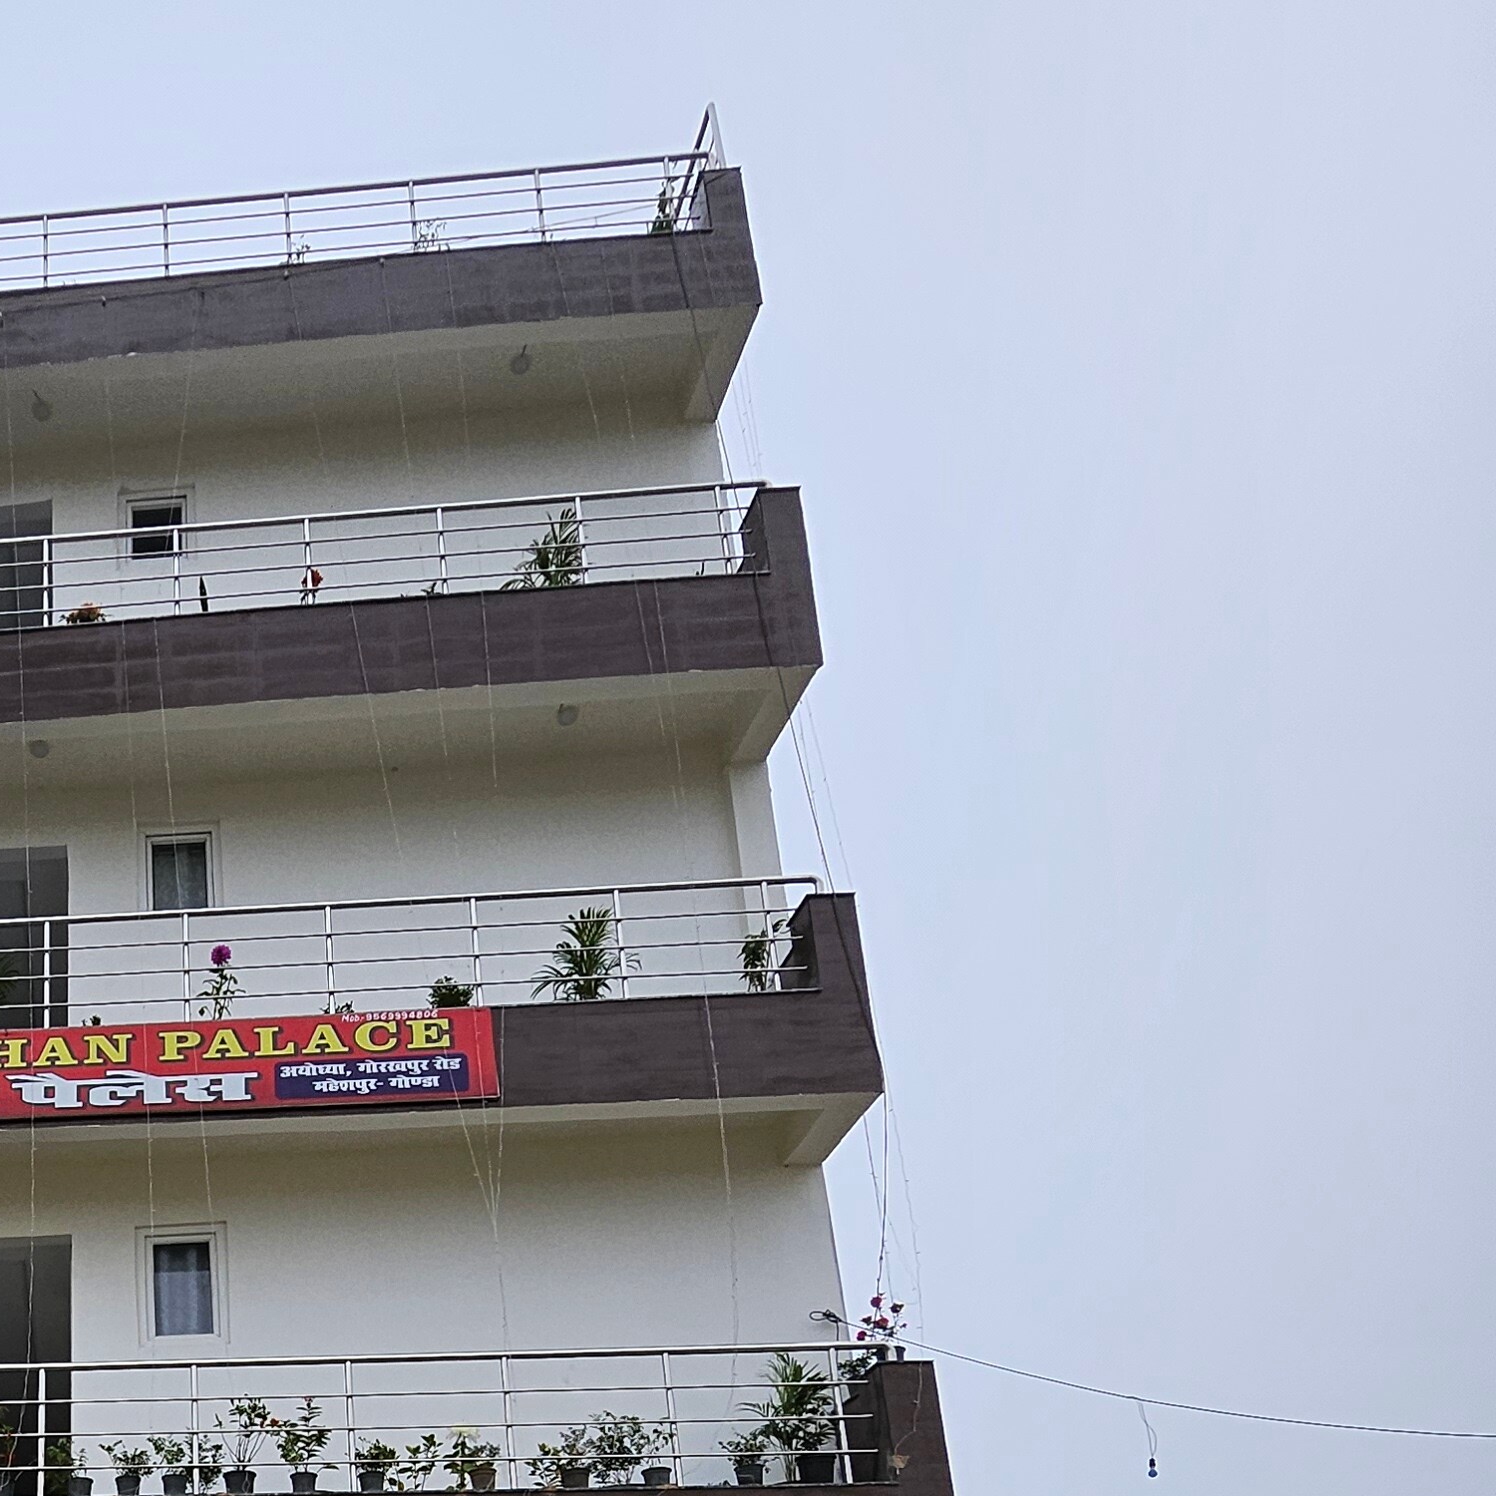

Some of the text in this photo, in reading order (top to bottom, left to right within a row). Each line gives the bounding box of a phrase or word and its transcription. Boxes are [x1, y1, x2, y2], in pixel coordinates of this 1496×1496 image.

[158, 1018, 452, 1063] PALACE
[280, 1056, 461, 1078] अयोध्या, गोरखपुर रोड
[388, 1075, 441, 1089] गोण्डा
[5, 1069, 258, 1108] पैलेस
